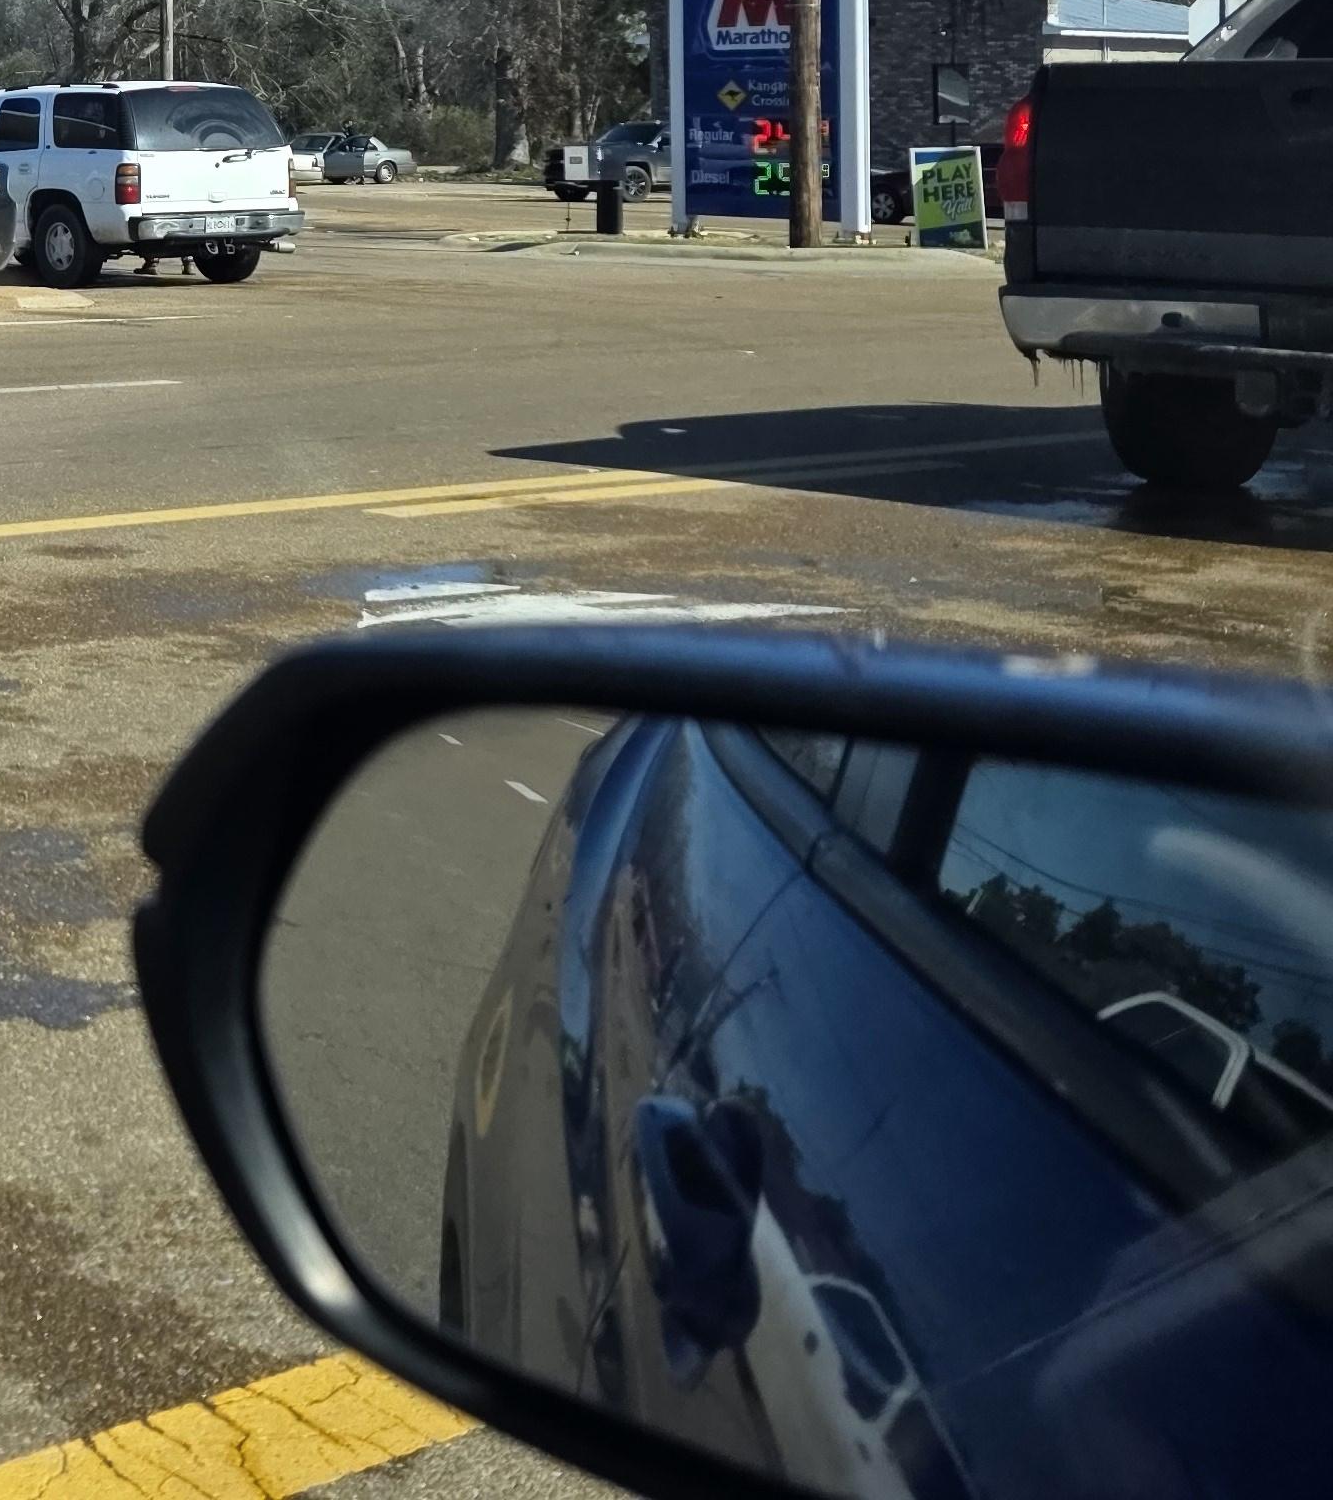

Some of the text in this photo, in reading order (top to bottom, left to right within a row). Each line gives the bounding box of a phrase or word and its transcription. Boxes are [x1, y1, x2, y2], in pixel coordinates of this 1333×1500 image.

[717, 29, 790, 45] Maratho
[689, 129, 735, 142] Regular
[691, 170, 730, 184] Diesel
[922, 163, 972, 185] PLAY
[923, 181, 975, 203] HERE
